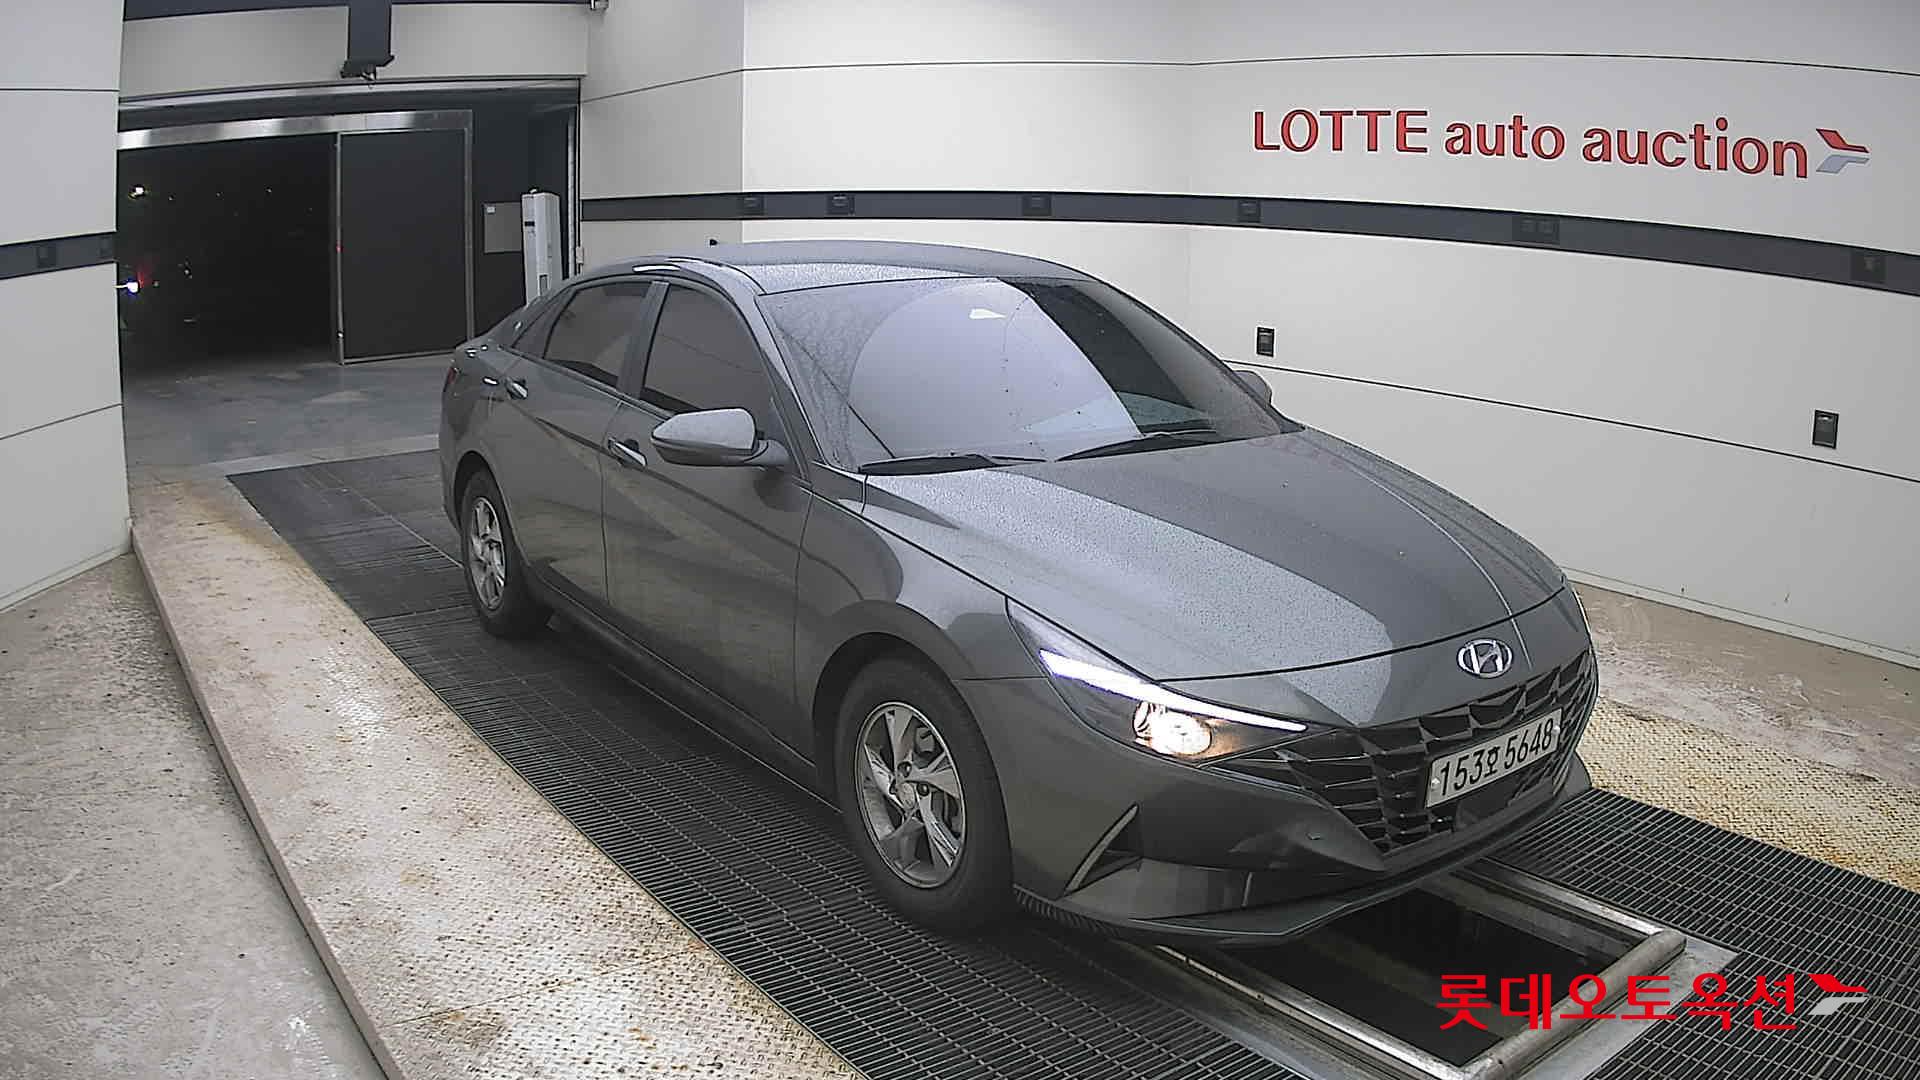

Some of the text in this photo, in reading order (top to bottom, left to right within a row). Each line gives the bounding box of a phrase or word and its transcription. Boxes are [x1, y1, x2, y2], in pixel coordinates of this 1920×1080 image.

[1253, 109, 1809, 178] LOTTE auto auction
[1504, 717, 1554, 769] 5648
